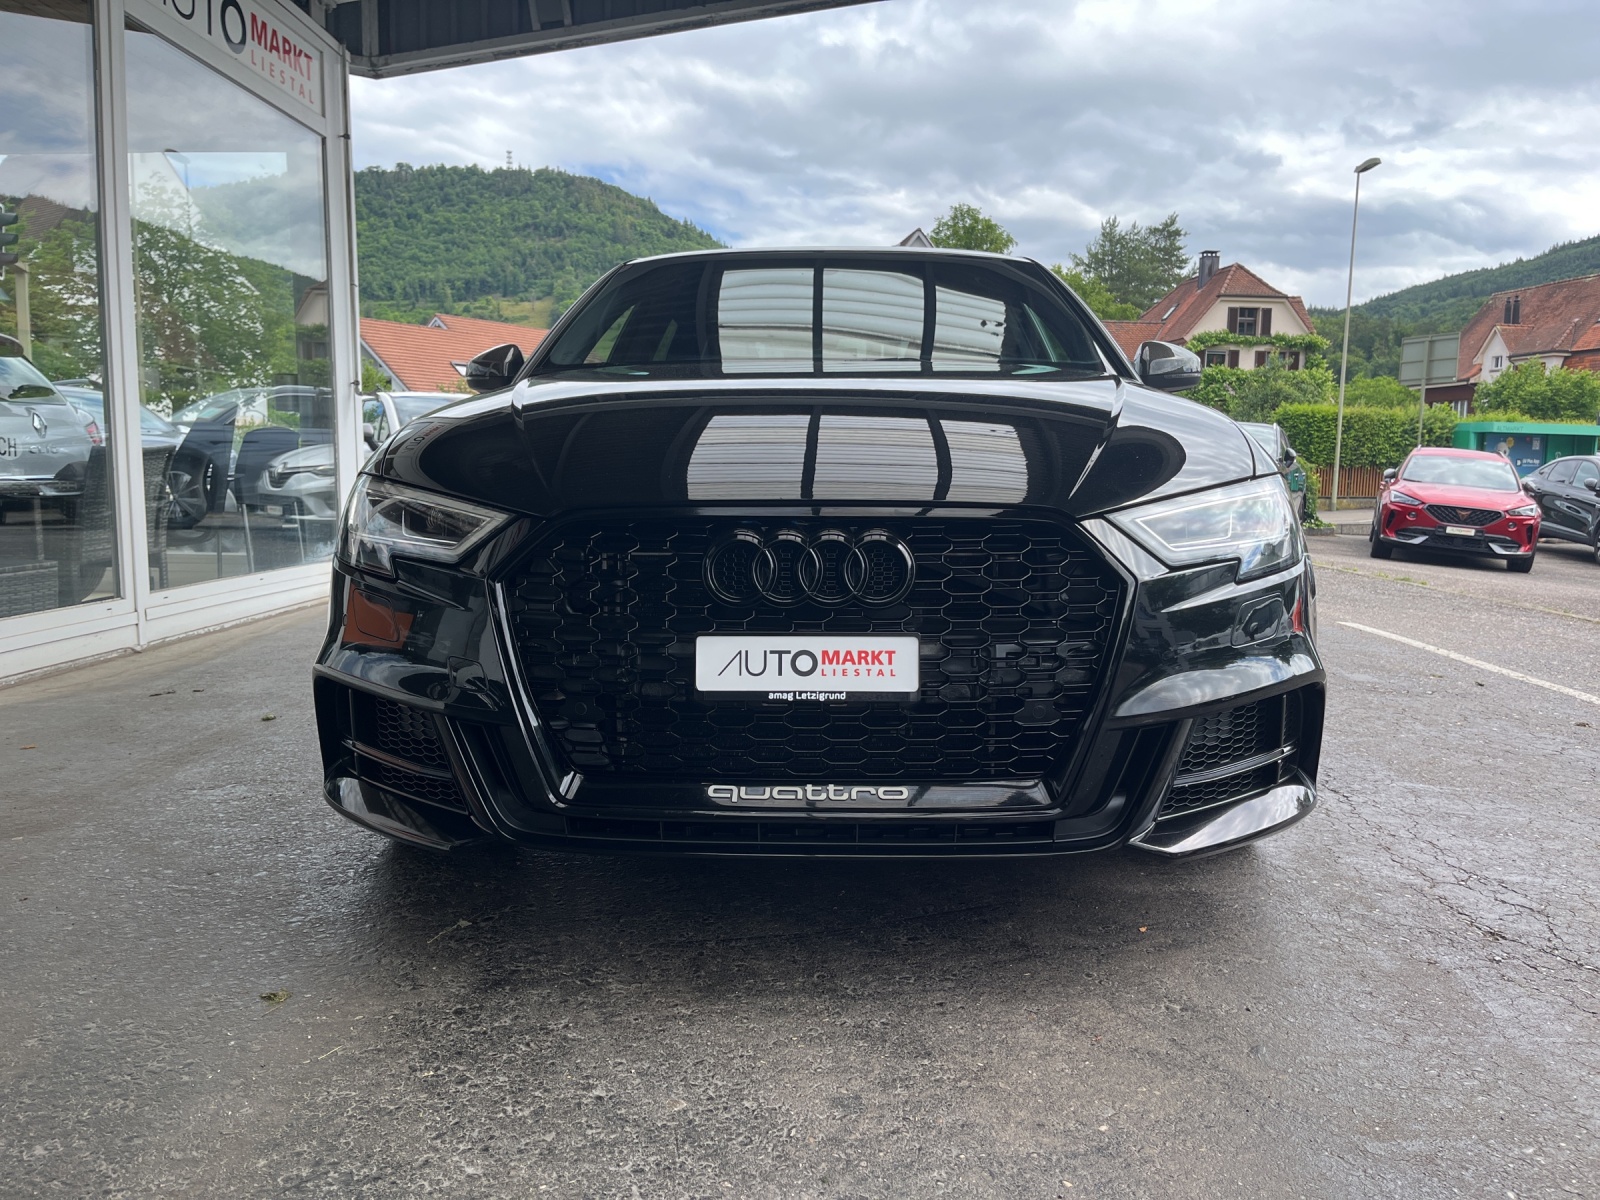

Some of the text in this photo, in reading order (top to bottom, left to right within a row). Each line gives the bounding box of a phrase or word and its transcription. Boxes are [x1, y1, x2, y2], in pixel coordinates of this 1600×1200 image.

[250, 12, 313, 81] MARKT
[251, 49, 314, 104] LIESTAL
[718, 649, 896, 677] AUTO MARKT
[821, 668, 896, 677] LIESTAL
[768, 691, 847, 701] amag Letzigrund
[707, 783, 910, 803] quattro
